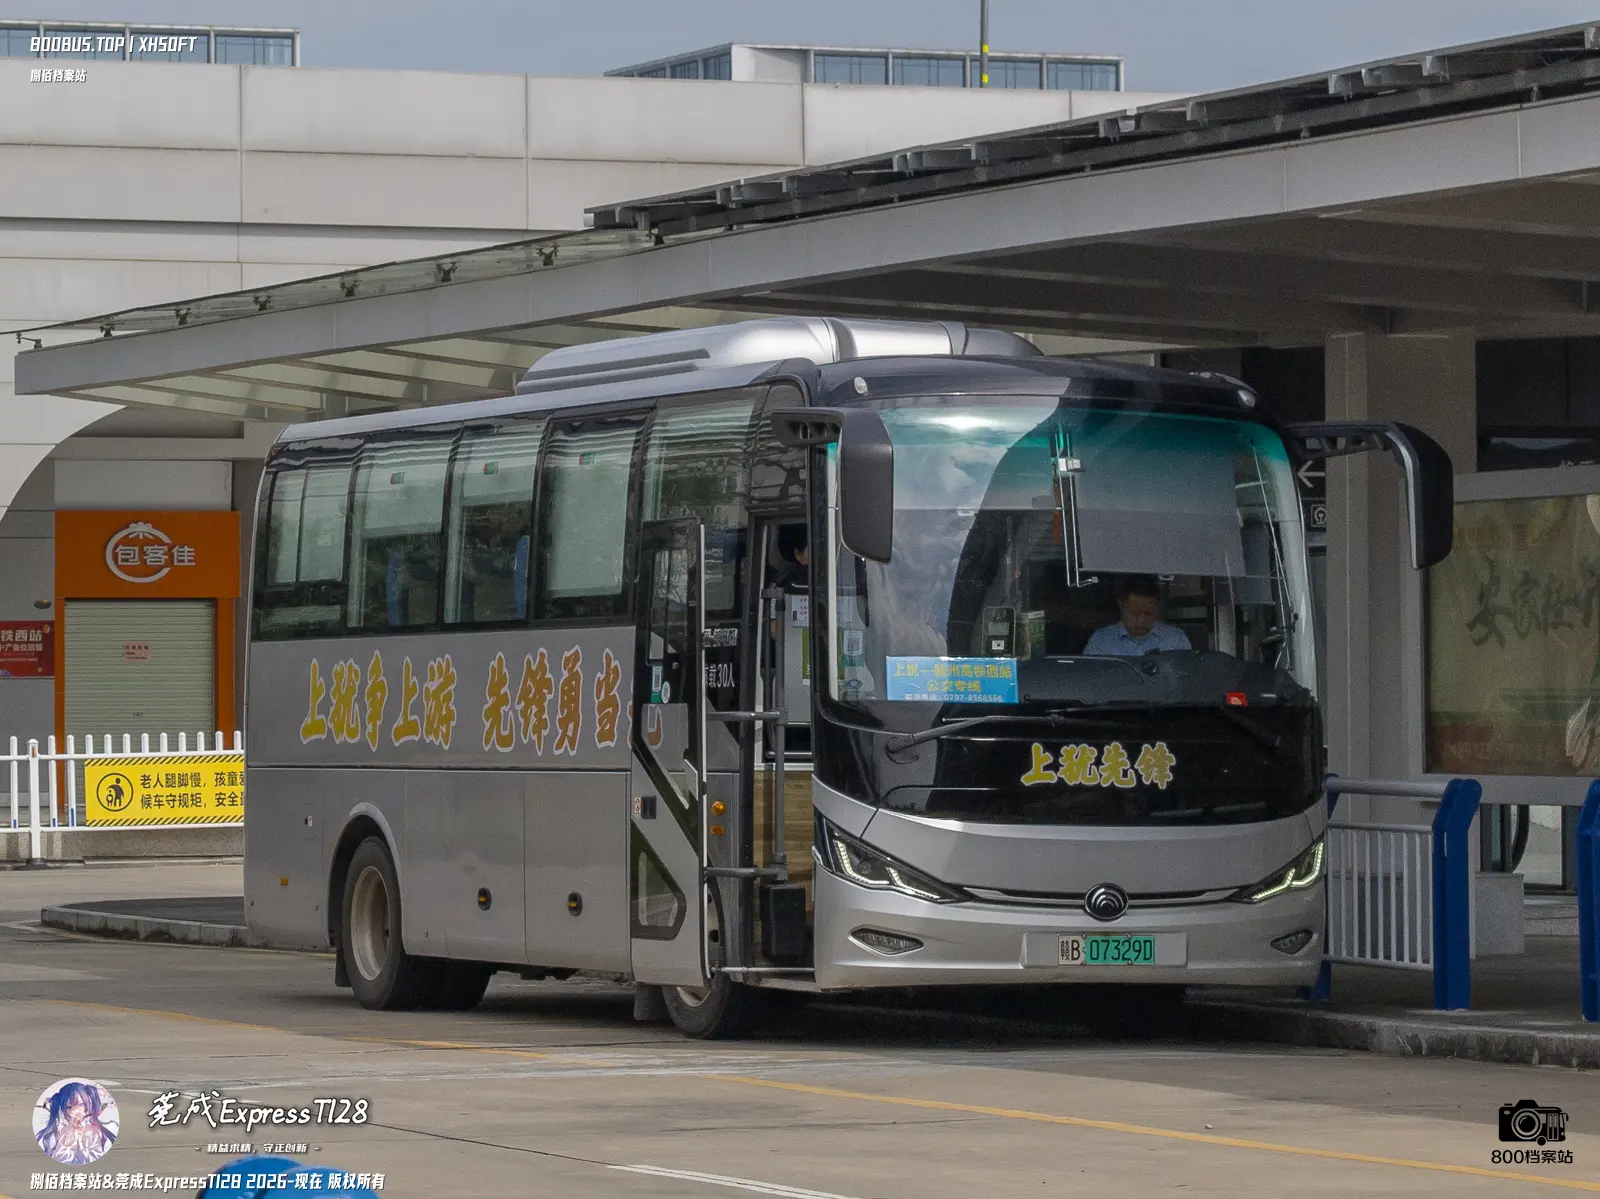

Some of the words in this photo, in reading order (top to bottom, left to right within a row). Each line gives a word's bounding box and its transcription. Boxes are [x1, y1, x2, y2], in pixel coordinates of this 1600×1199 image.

[115, 544, 196, 566] 包客佳
[300, 649, 458, 752] 上犹争上游
[1021, 741, 1176, 790] 上犹先锋
